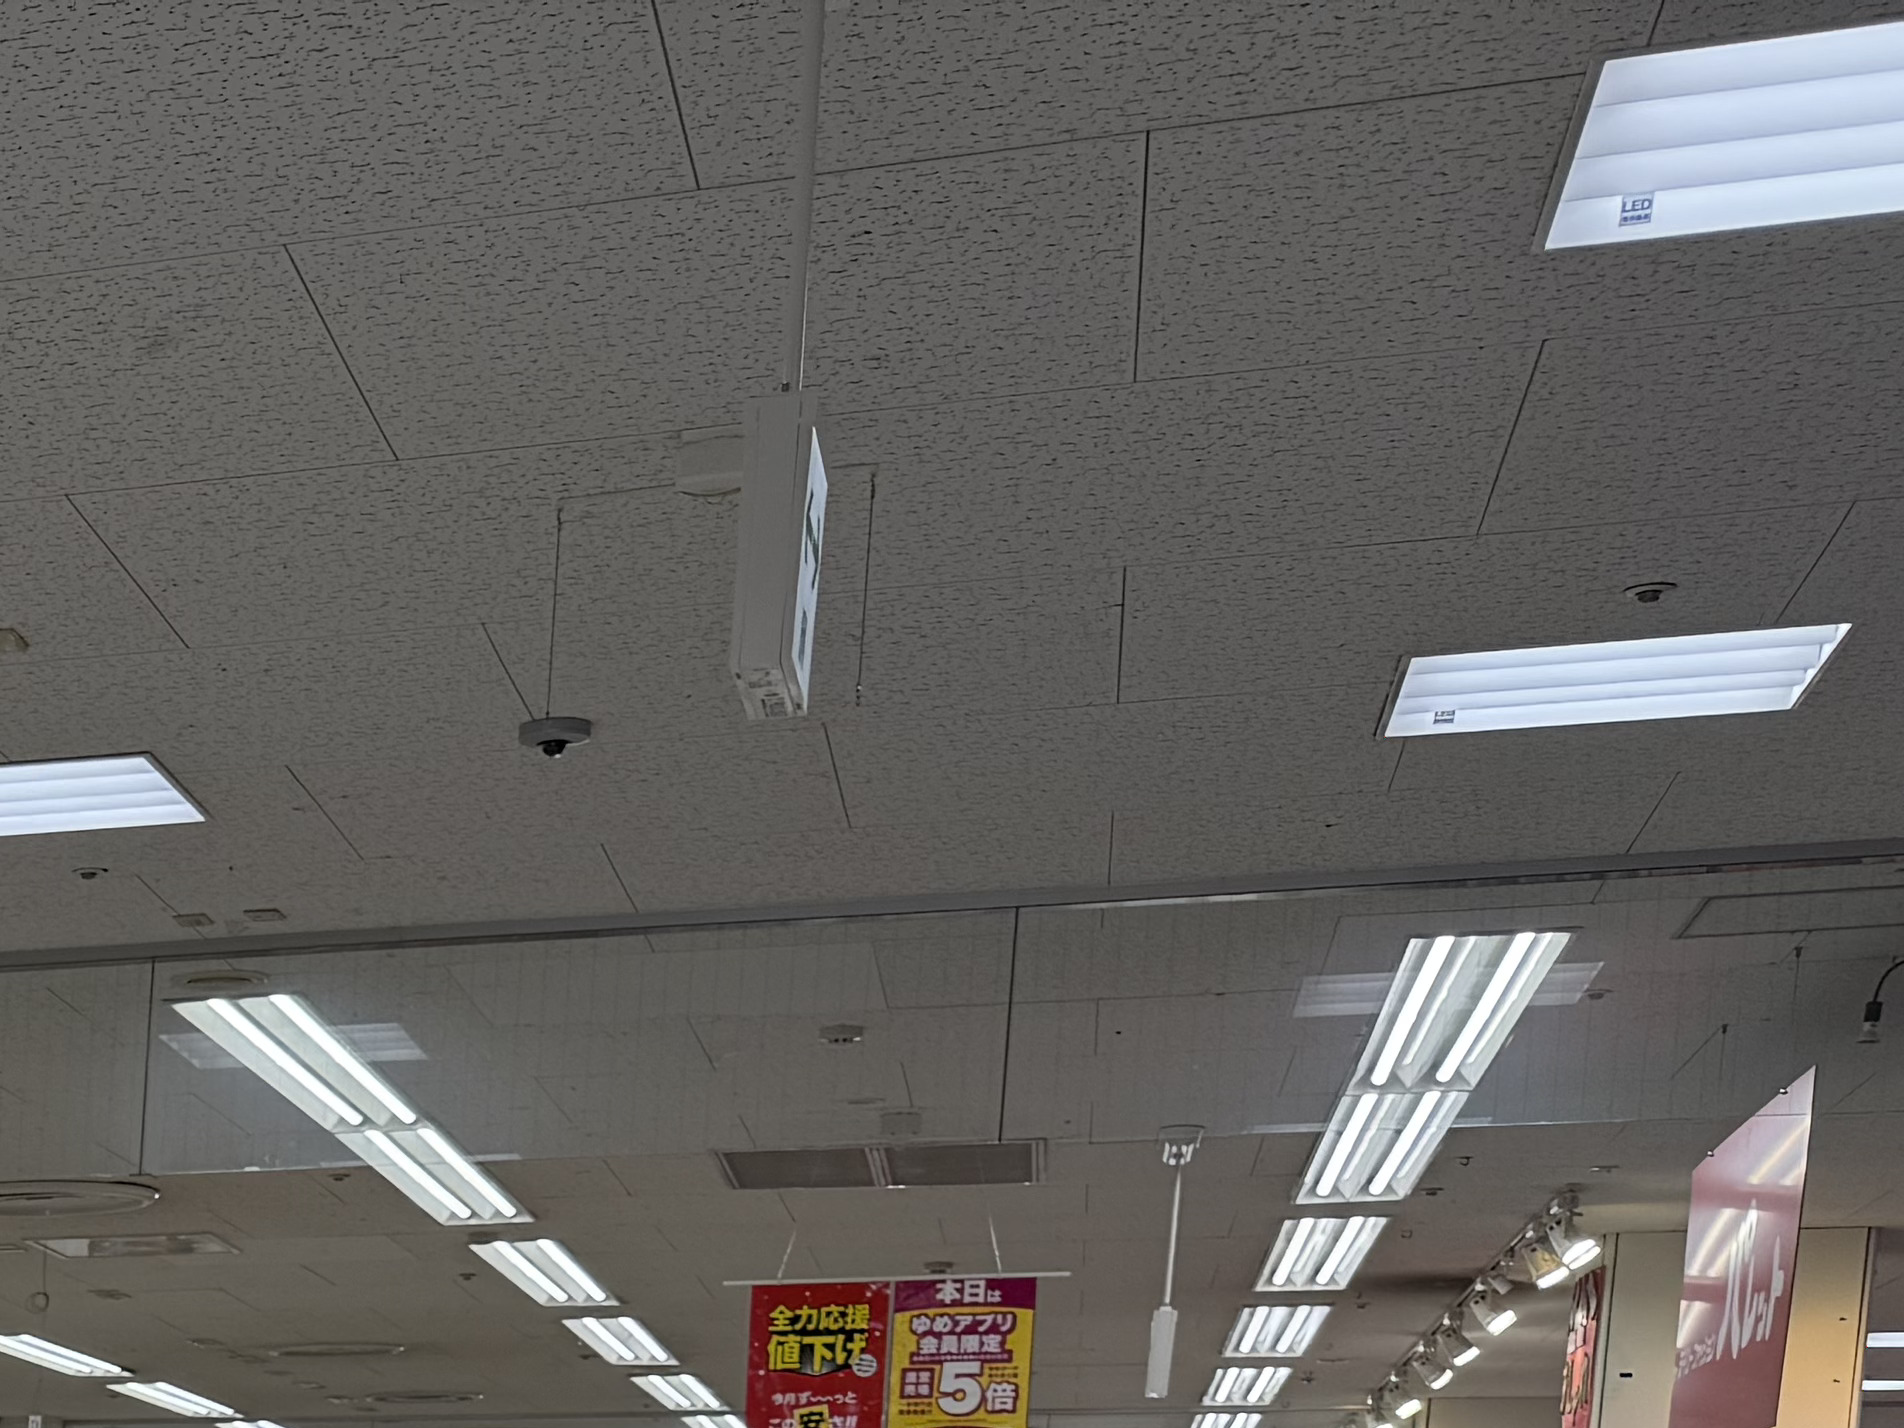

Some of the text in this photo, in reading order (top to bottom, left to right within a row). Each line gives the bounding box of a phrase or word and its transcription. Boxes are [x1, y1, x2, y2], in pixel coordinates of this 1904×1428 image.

[935, 1279, 1003, 1305] 本日は
[768, 1303, 870, 1332] 全力応援
[911, 1313, 1016, 1334] ゆめアプリ
[767, 1331, 869, 1373] 値下げ
[918, 1335, 1003, 1355] 会員限定
